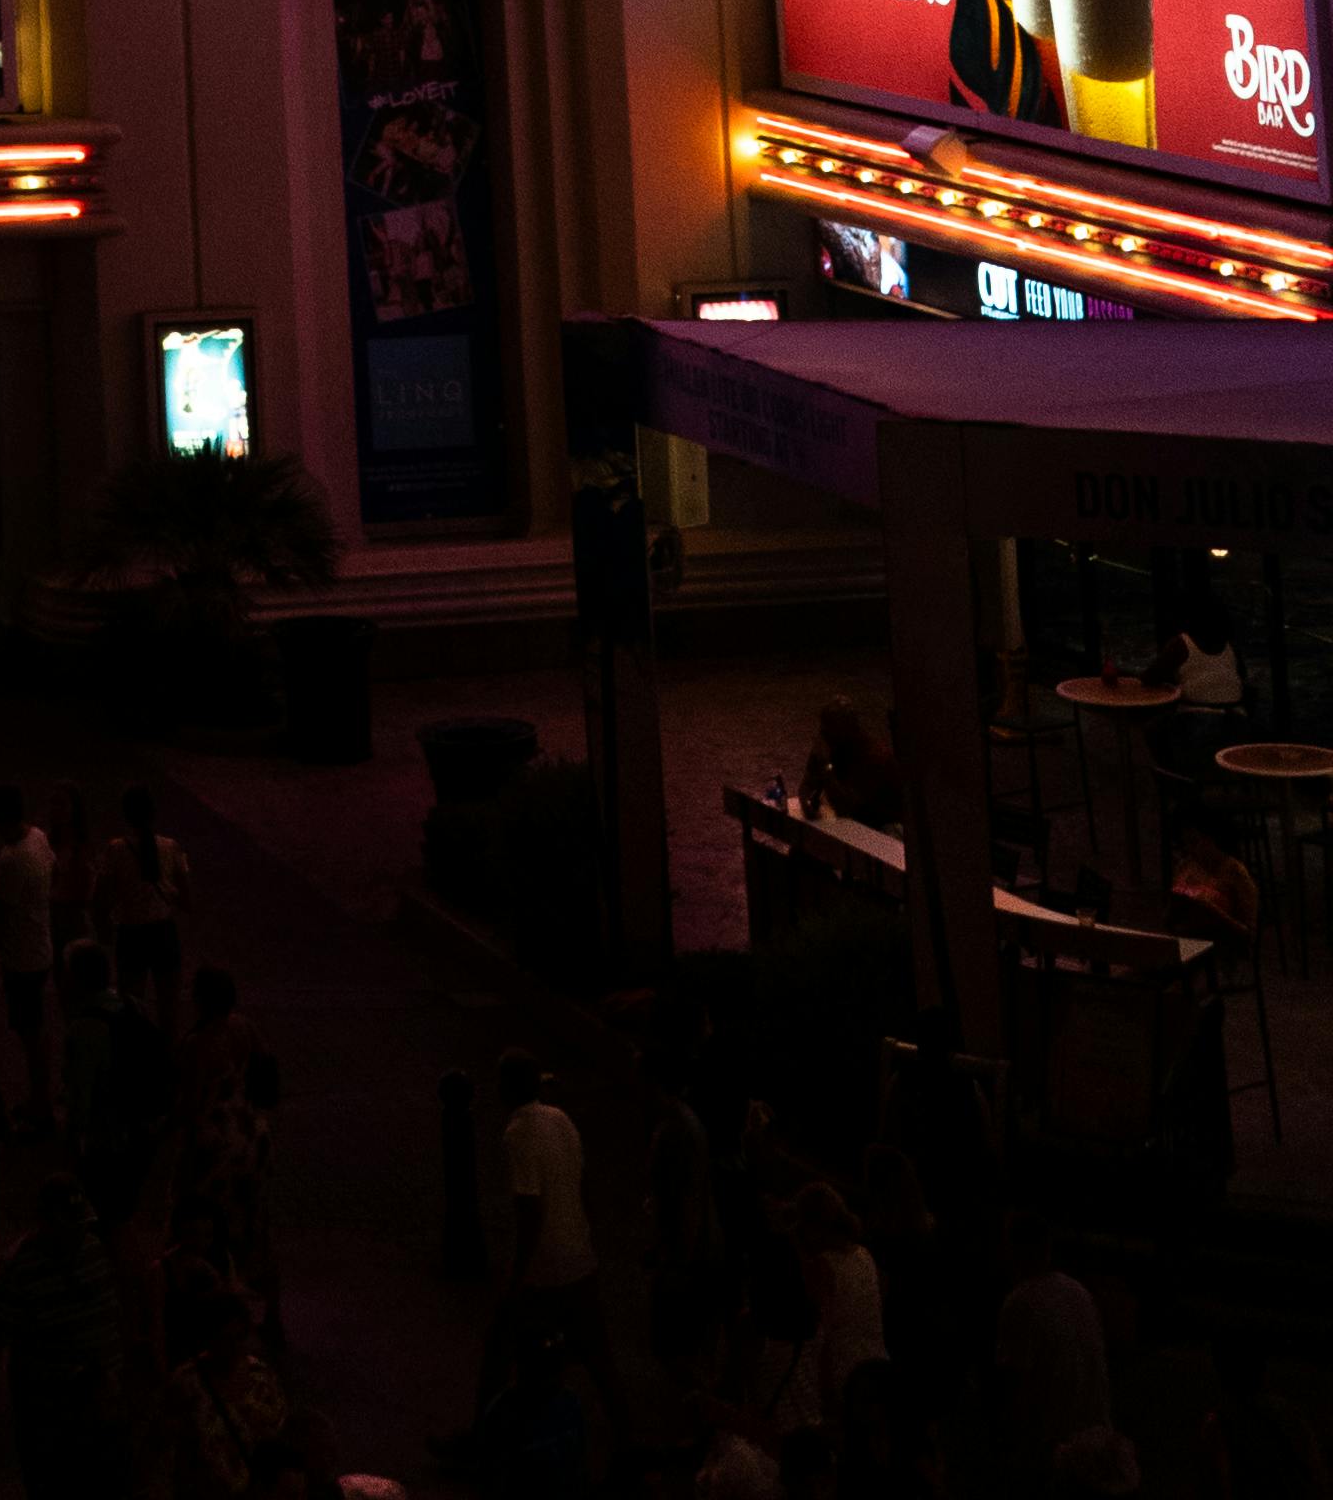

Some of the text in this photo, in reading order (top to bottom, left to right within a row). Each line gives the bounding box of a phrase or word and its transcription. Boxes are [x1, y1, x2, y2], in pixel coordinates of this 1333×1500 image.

[1224, 14, 1316, 137] BIRD
[1257, 101, 1284, 129] BAR
[1024, 278, 1052, 318] FEED
